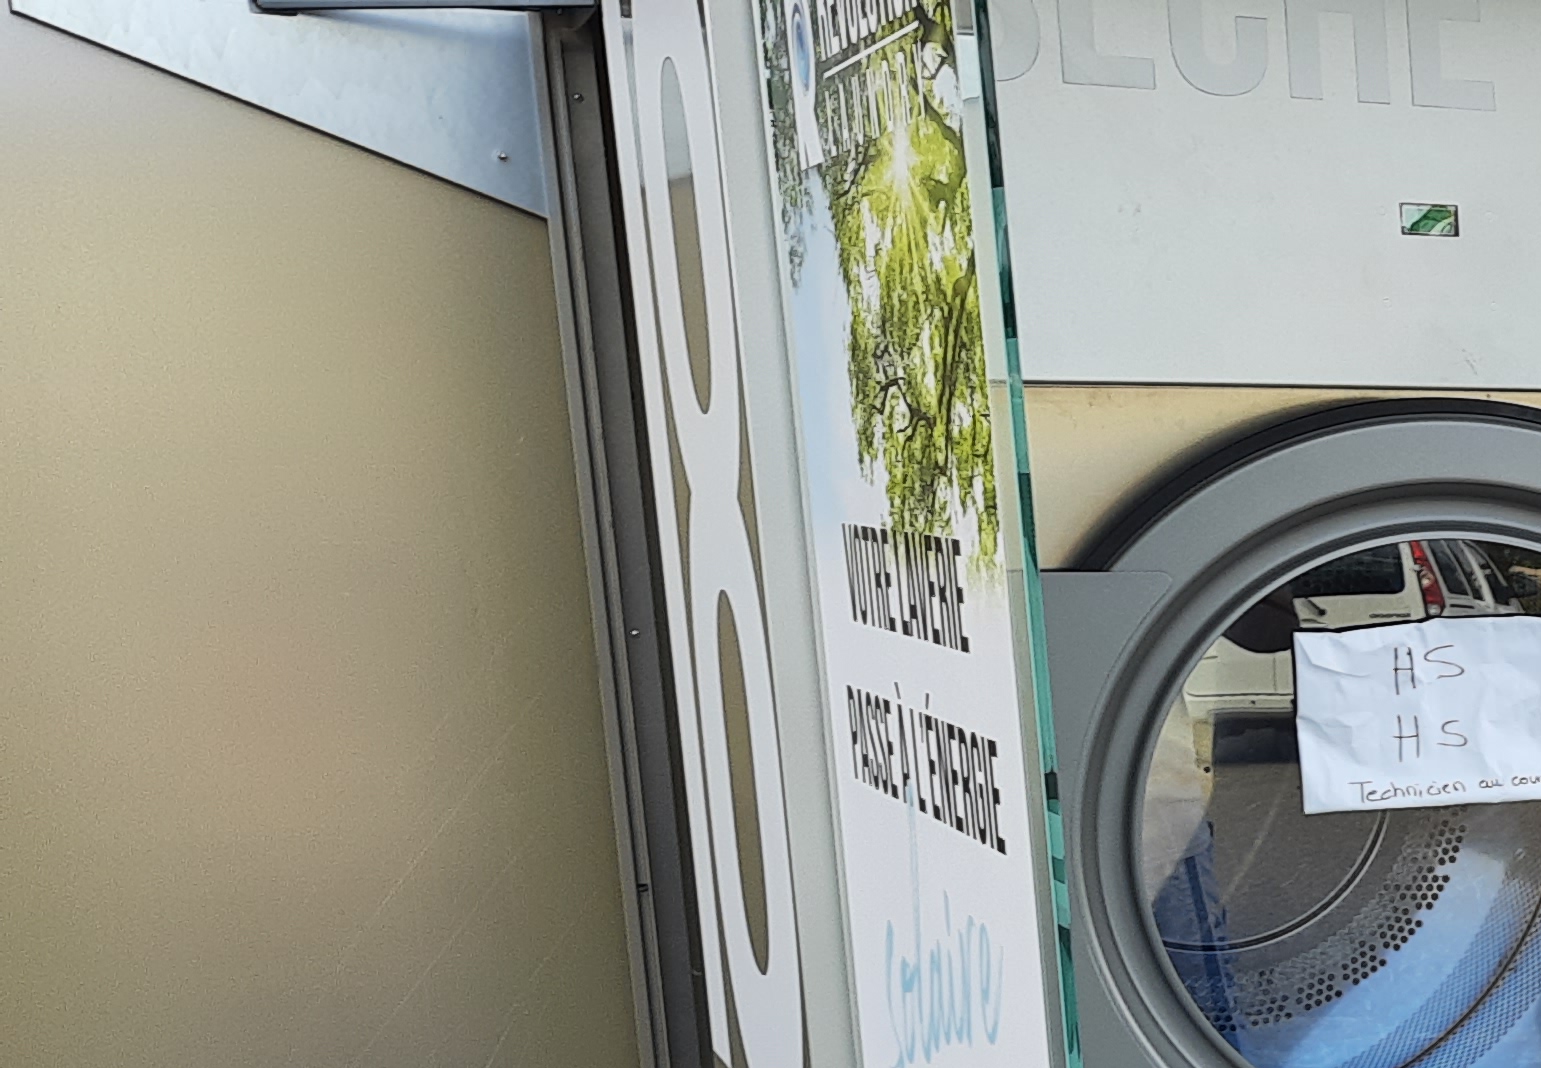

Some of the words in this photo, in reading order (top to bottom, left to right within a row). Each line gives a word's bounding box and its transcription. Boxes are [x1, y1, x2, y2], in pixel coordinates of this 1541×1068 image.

[842, 523, 897, 632] VOTRE
[892, 530, 970, 654] LAVERIE
[846, 684, 899, 800] PASSE
[909, 693, 1006, 855] L'ÉNERGIE
[1479, 778, 1502, 788] au
